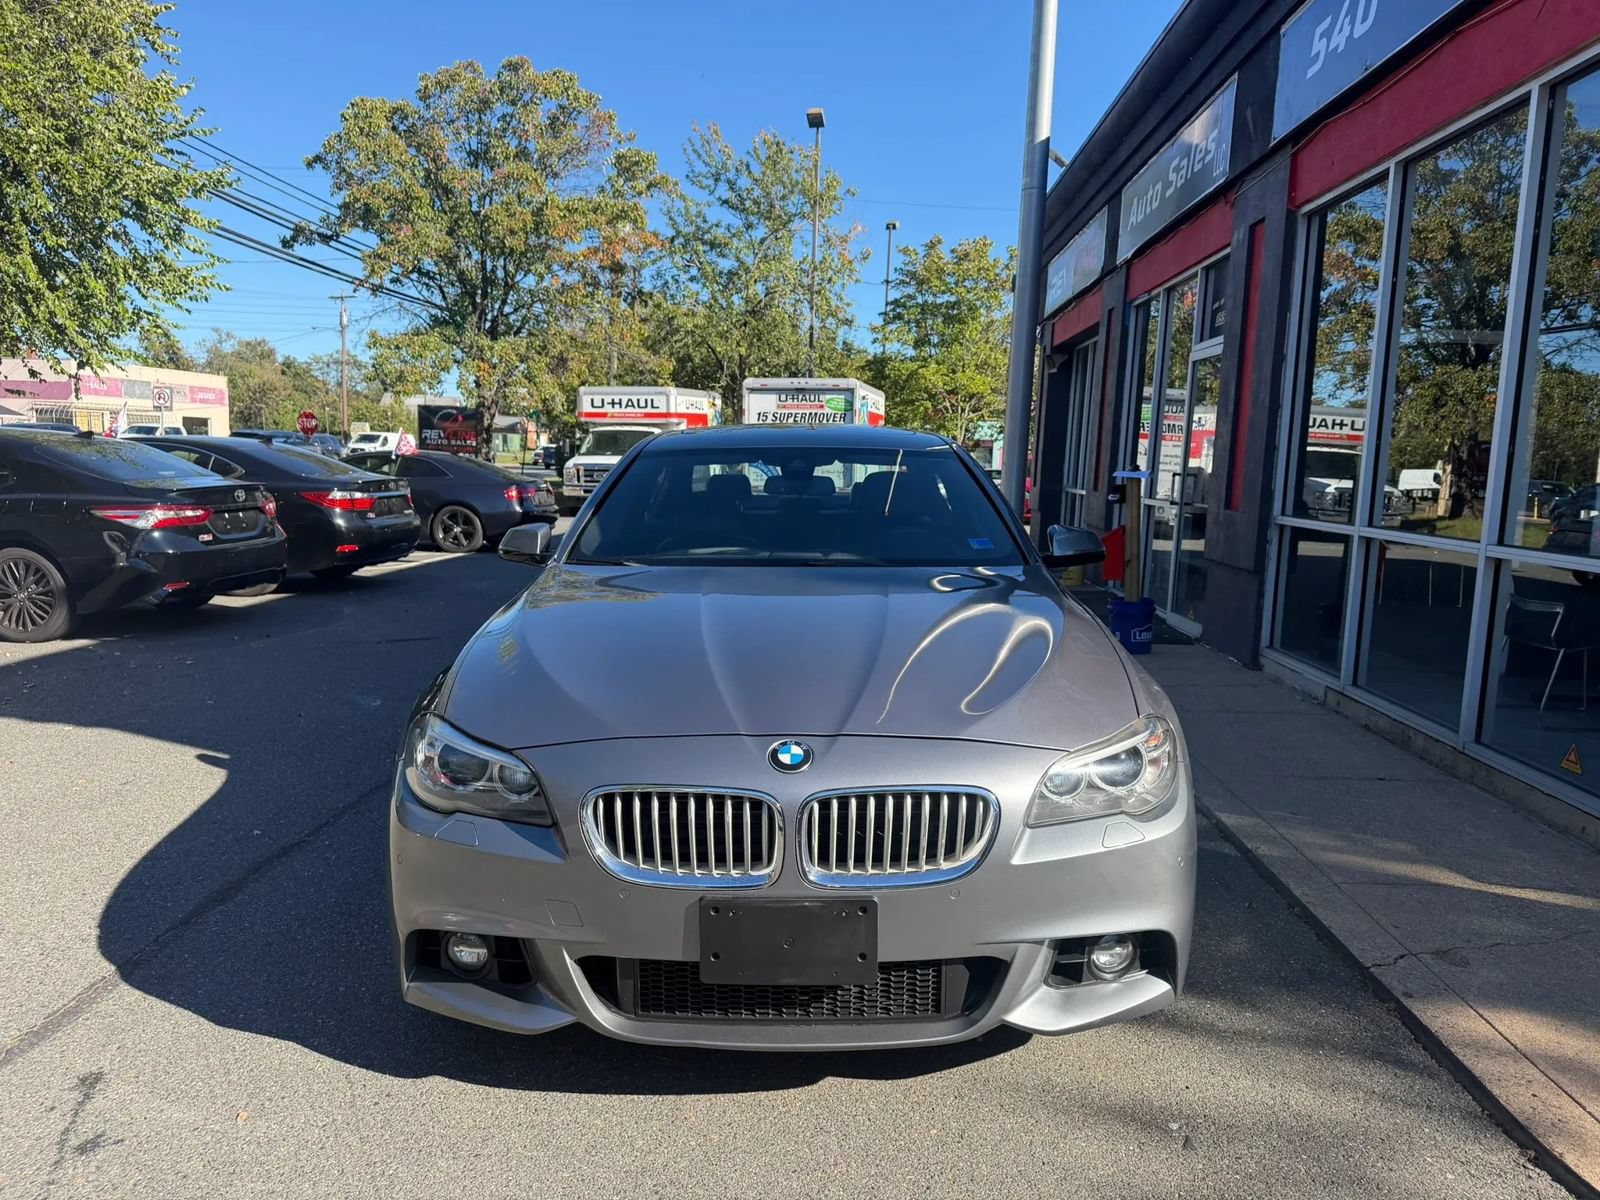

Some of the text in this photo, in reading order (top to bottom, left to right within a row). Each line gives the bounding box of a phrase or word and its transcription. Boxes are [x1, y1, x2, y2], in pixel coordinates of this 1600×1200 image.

[1127, 129, 1218, 231] Auto Sales
[590, 398, 660, 409] U-HAUL
[778, 393, 824, 403] U-HAUL
[771, 411, 847, 423] SUPERMOVER
[298, 418, 317, 429] STOP
